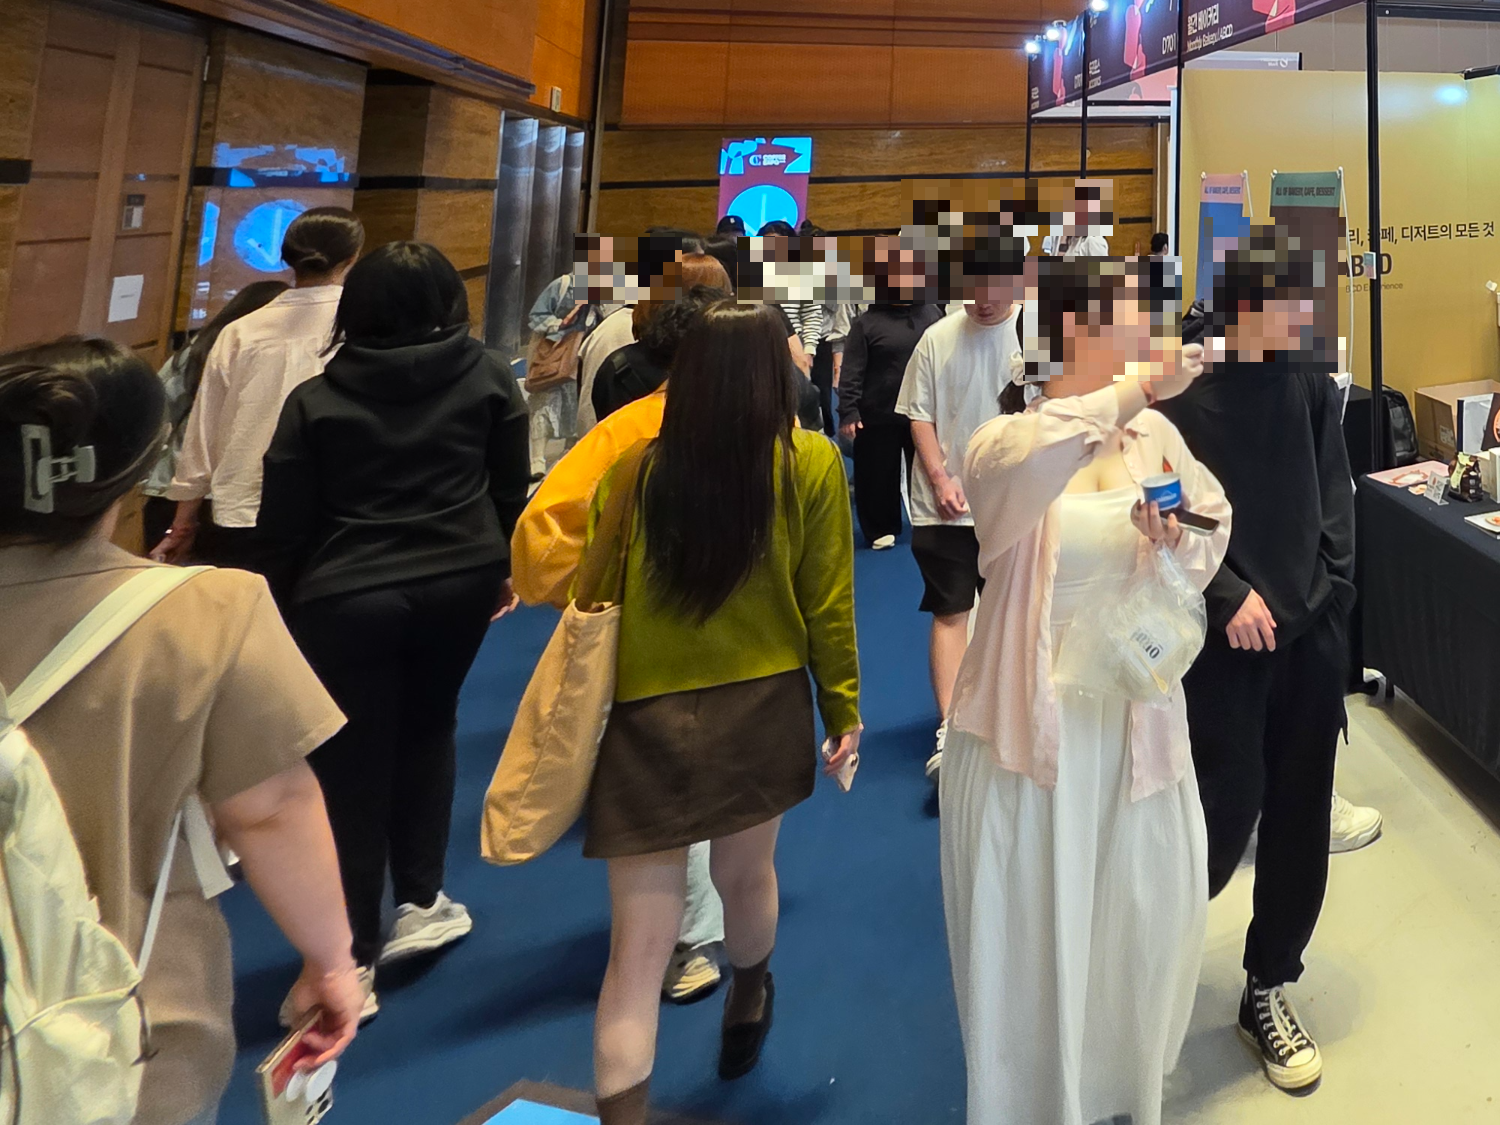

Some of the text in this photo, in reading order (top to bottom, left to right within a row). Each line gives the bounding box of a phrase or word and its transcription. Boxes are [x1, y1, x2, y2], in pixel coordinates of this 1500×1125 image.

[1401, 223, 1452, 242] 디저트의
[1455, 222, 1480, 238] 모든
[1483, 221, 1495, 238] 것
